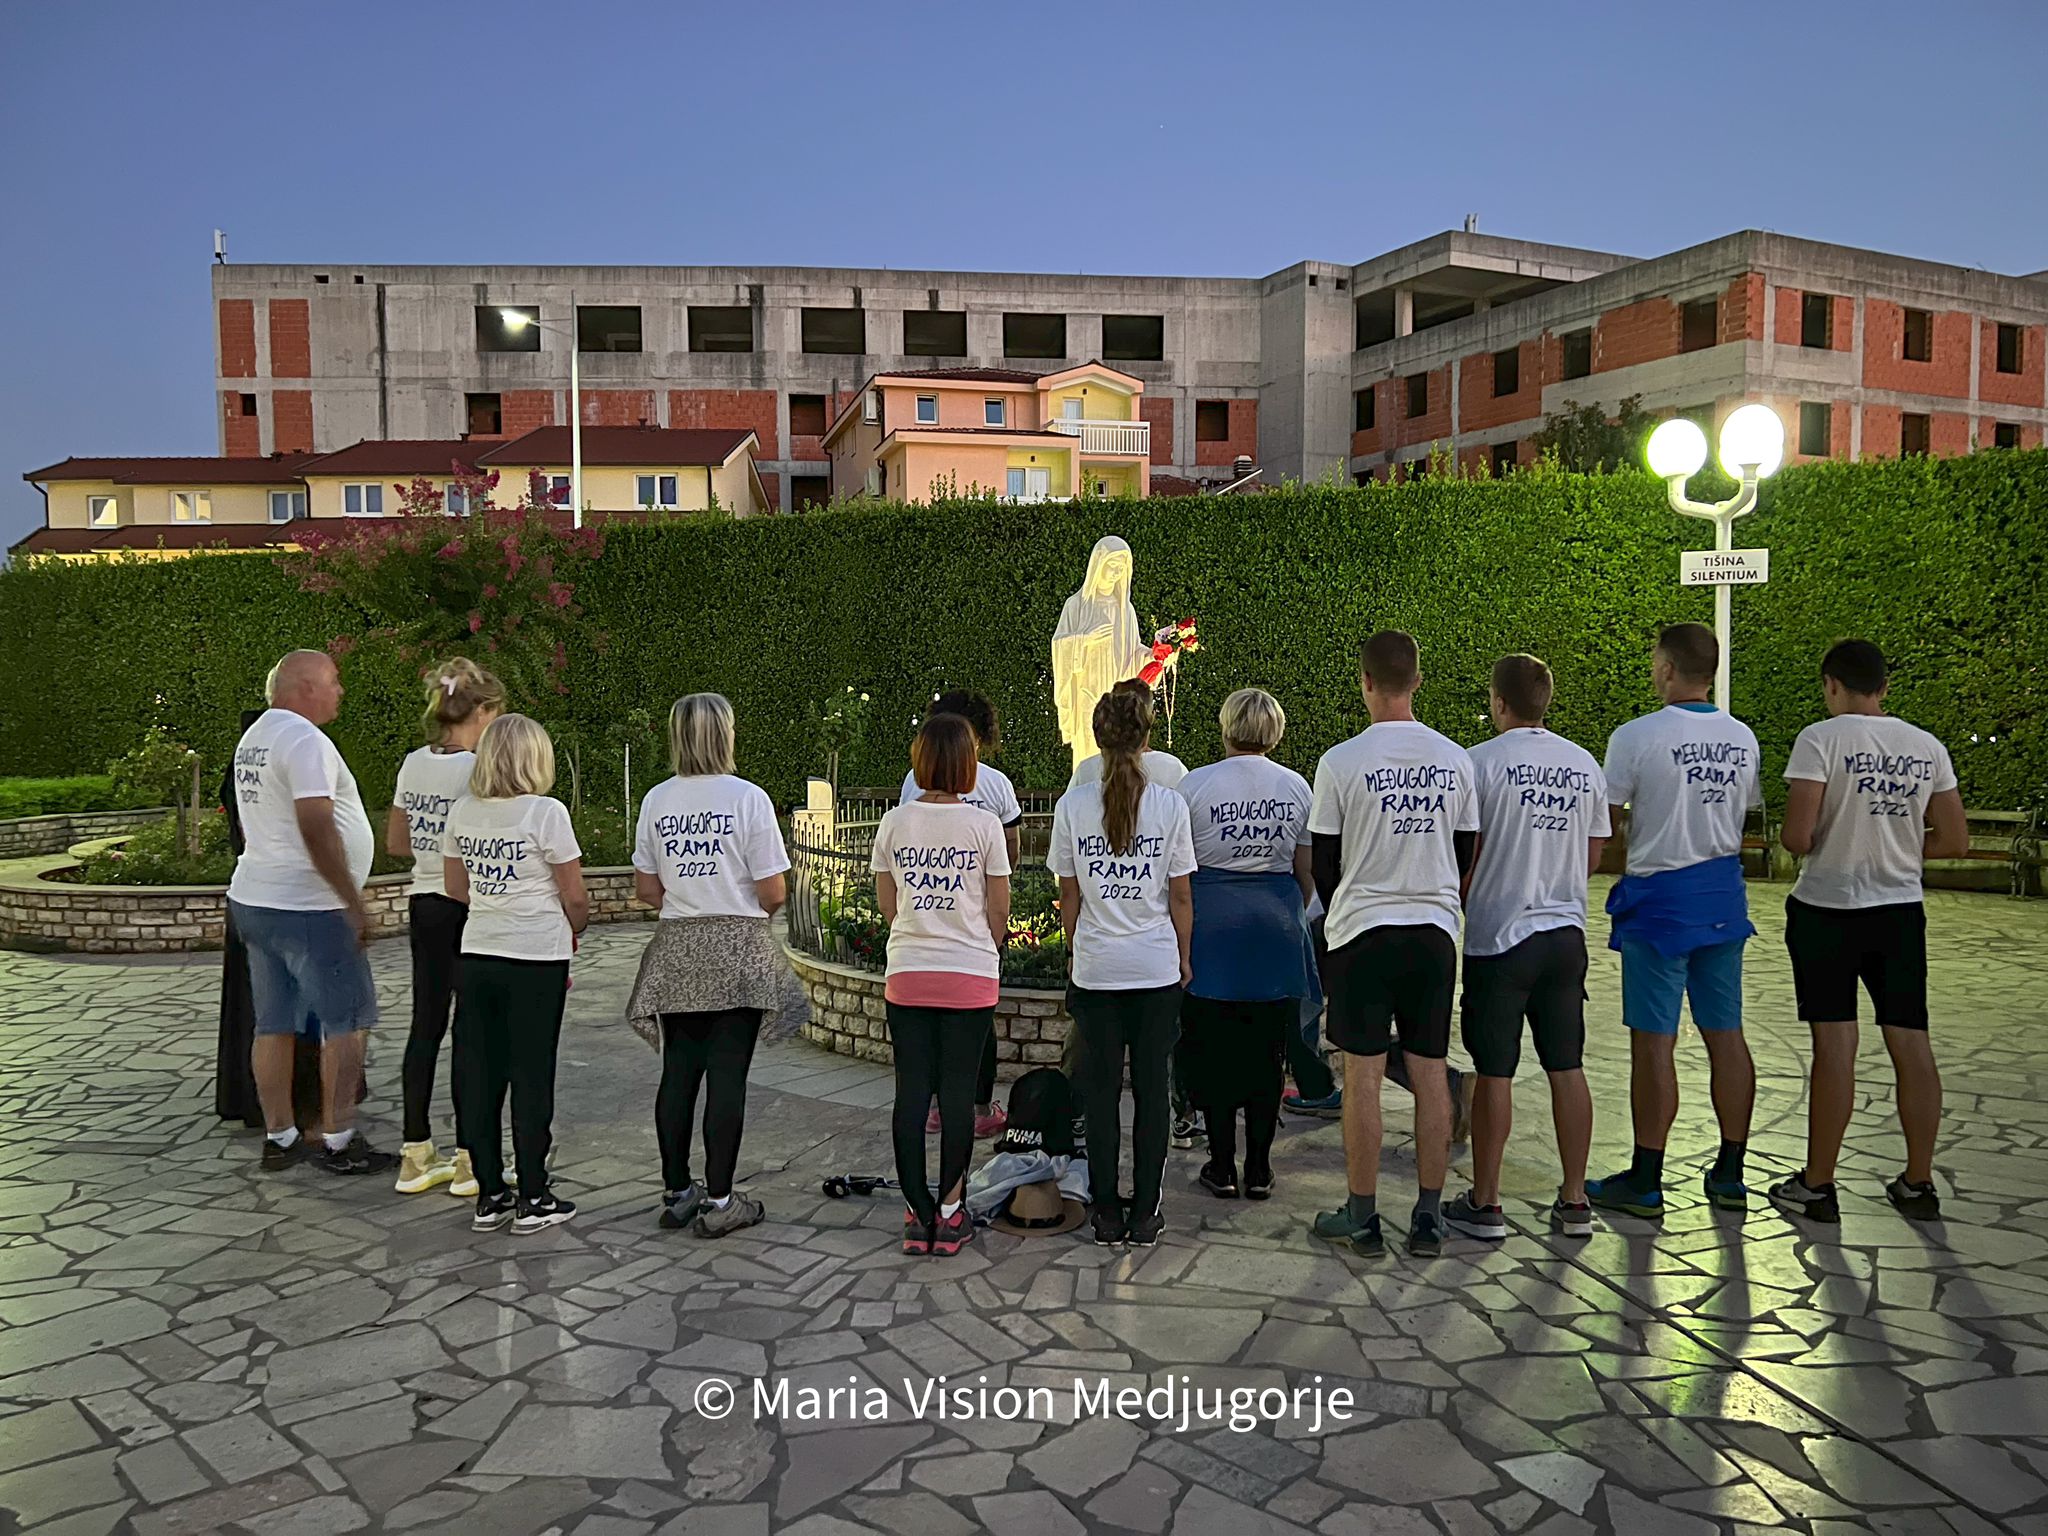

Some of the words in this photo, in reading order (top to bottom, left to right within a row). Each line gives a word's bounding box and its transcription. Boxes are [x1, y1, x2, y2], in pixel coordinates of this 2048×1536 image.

[1704, 555, 1745, 567] TIŠINA
[1691, 570, 1758, 581] SILENTIUM
[1686, 766, 1737, 786] RAMA
[1844, 752, 1933, 781] MEĐUGORJE
[236, 768, 263, 787] RAMA
[1364, 764, 1456, 792] MEĐUGORJE
[1506, 763, 1590, 793] MEĐUGORJE
[1857, 776, 1919, 798] RAMA
[1380, 793, 1446, 814] RAMA
[1520, 788, 1578, 812] RAMA
[1210, 798, 1295, 824] MEĐUGORJE
[654, 811, 734, 838] MEĐUGORJE
[1220, 824, 1285, 841] RAMA
[1392, 816, 1436, 835] 2022
[664, 838, 724, 858] RAMA
[893, 846, 979, 870] MEĐUGORJE
[1231, 844, 1273, 858] 2022
[465, 859, 519, 881] RAMA
[676, 861, 718, 878] 2022
[1088, 860, 1152, 881] RAMA
[904, 871, 965, 892] RAMA
[1099, 883, 1143, 900] 2022
[912, 894, 956, 911] 2022
[1006, 1128, 1043, 1145] PUMA
